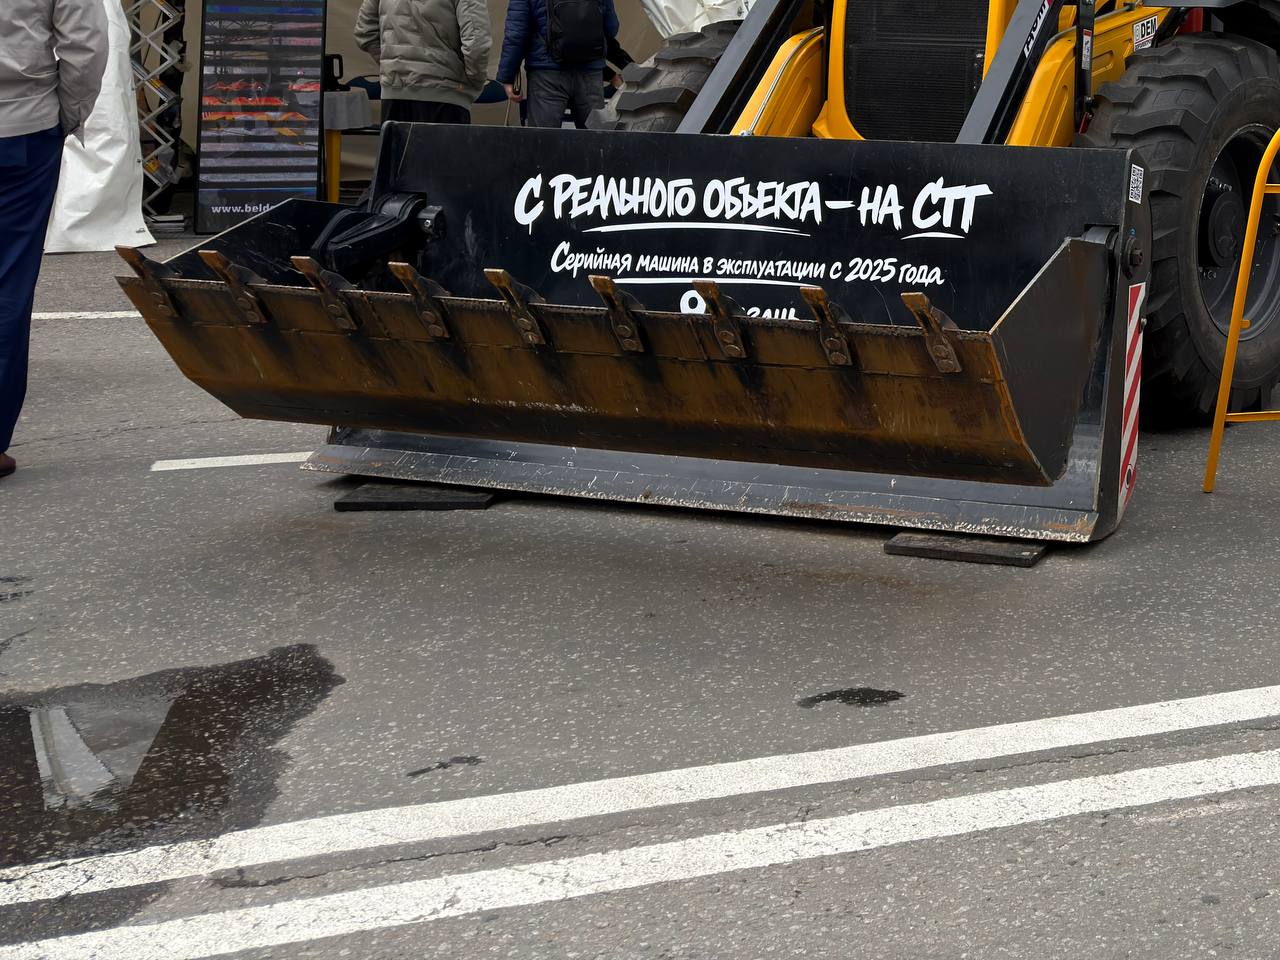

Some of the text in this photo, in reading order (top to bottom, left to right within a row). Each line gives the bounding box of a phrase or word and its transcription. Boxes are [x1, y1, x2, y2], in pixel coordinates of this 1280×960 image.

[1140, 16, 1158, 38] DEM
[513, 173, 544, 235] С
[549, 173, 697, 221] РЕАЛЬНОГО
[702, 176, 823, 226] ОБЪЕКТА
[912, 176, 994, 233] СТТ
[550, 241, 632, 279] Серийная
[844, 256, 898, 283] 2025
[898, 263, 945, 287] года
